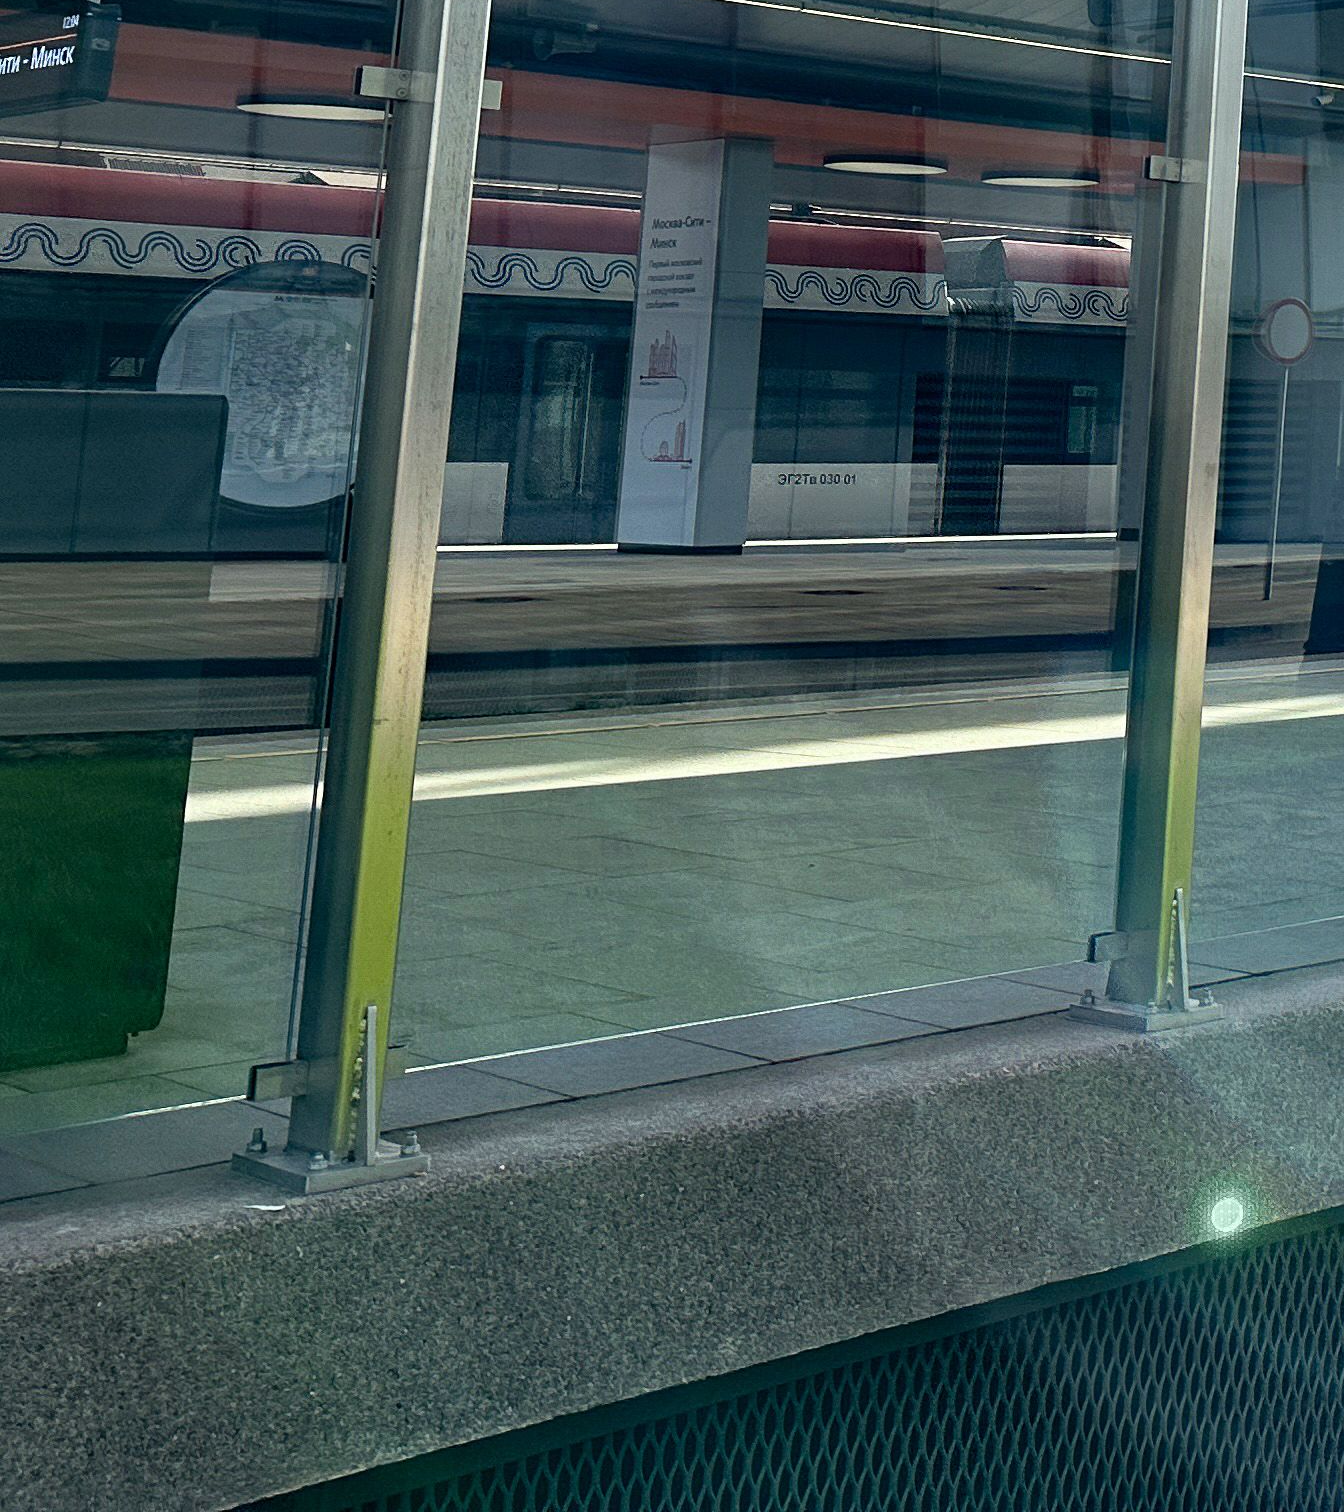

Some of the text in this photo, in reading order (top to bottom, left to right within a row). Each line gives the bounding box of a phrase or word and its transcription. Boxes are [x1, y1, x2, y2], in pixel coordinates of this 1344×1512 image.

[30, 45, 76, 70] Минск
[651, 216, 705, 230] Москва-Сити
[819, 473, 841, 486] 030
[843, 473, 857, 486] 01
